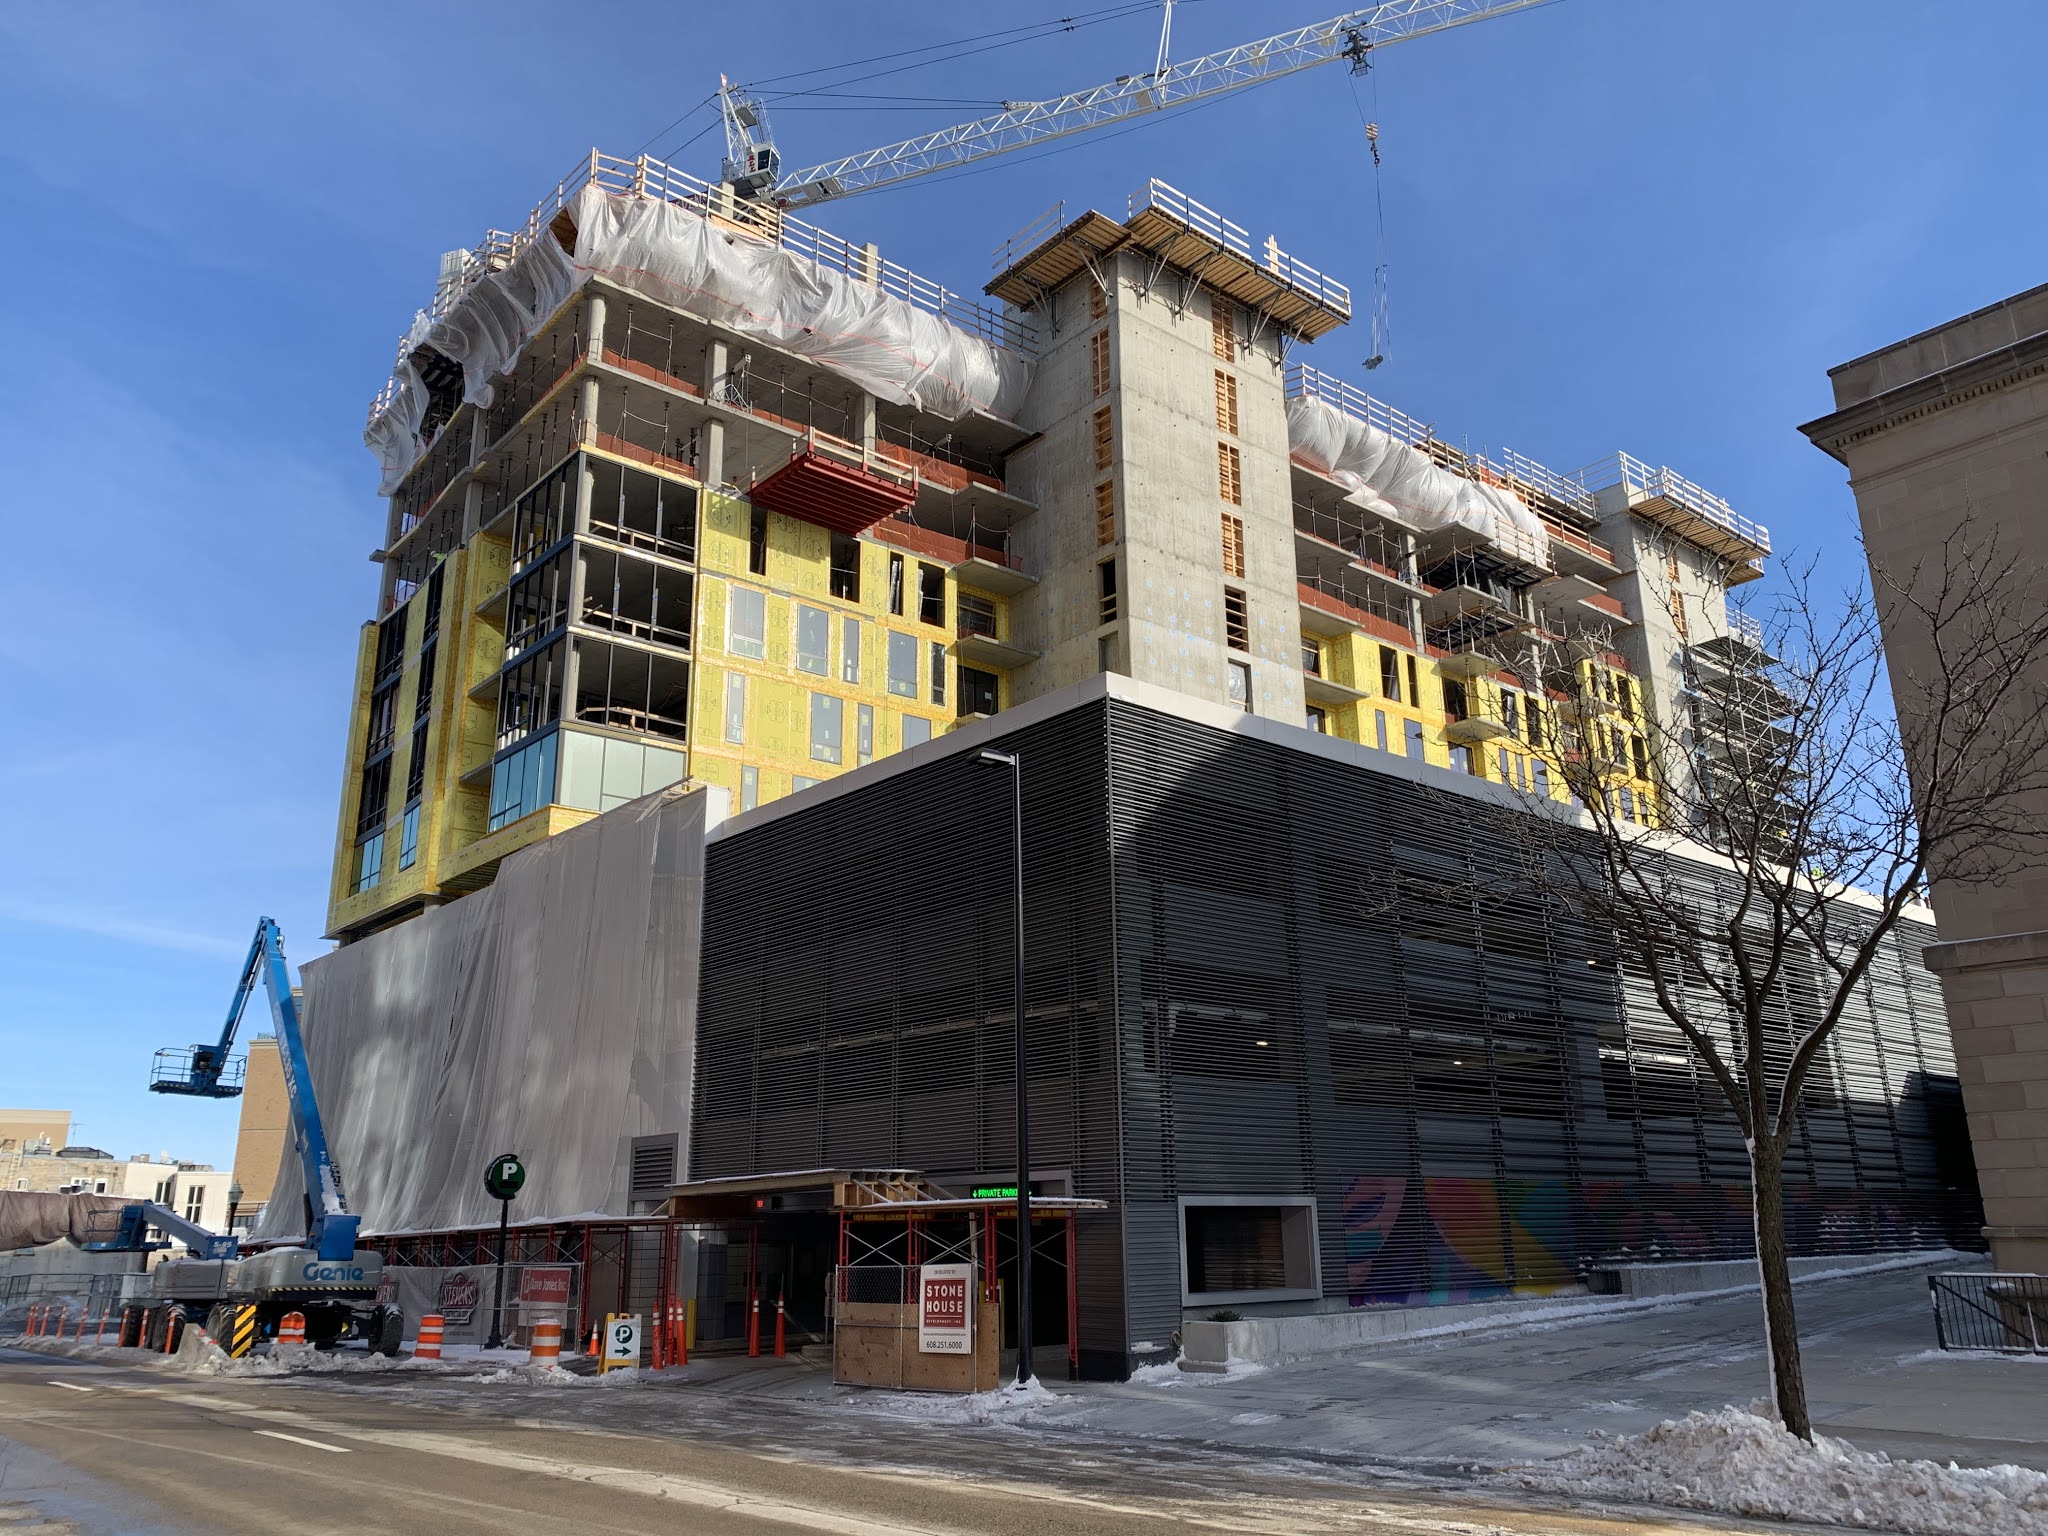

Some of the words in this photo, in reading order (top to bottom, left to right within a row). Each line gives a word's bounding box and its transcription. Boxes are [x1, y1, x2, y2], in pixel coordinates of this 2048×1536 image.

[502, 1162, 518, 1180] P
[978, 1188, 1002, 1198] PRIVATE
[303, 1262, 364, 1281] Genie
[530, 1278, 543, 1291] Dave
[542, 1278, 558, 1291] Jones
[443, 1285, 474, 1305] STEVENS
[926, 1285, 963, 1298] STONE
[926, 1301, 963, 1313] HOUSE
[926, 1341, 963, 1349] 608.251.6000
